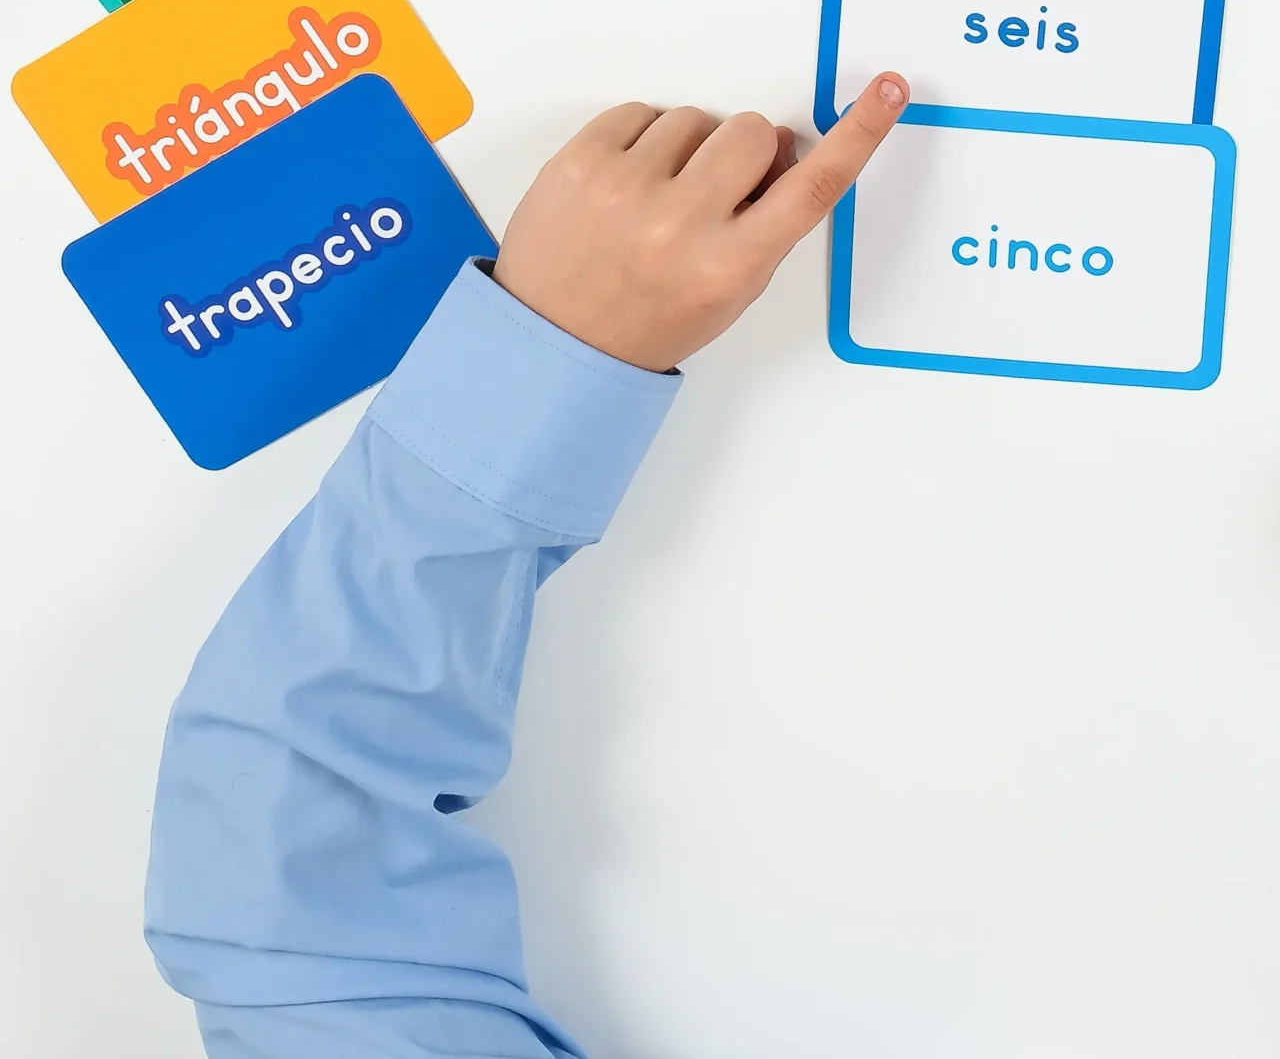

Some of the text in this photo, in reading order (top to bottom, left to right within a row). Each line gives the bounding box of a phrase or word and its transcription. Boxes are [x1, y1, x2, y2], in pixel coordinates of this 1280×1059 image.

[963, 5, 1079, 54] seis
[951, 224, 1114, 277] cinco
[164, 207, 403, 350] trapecio
